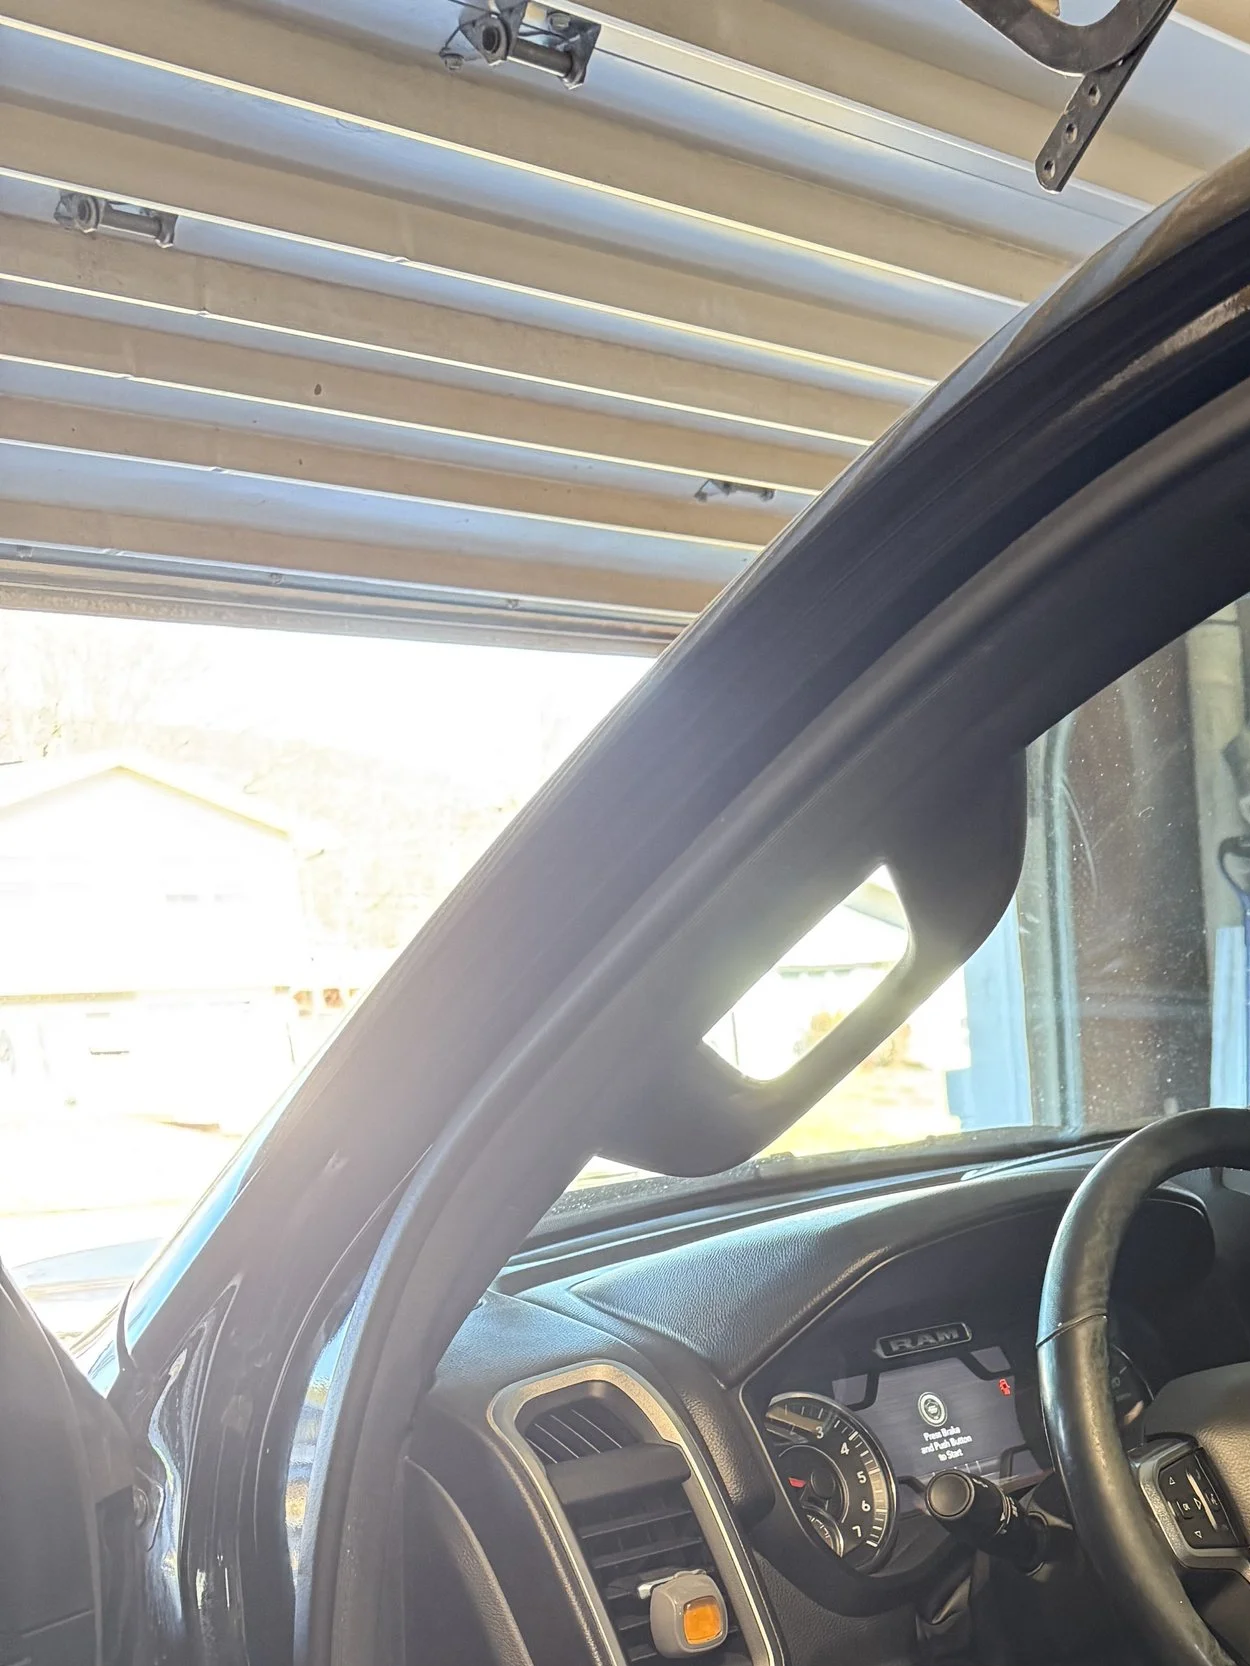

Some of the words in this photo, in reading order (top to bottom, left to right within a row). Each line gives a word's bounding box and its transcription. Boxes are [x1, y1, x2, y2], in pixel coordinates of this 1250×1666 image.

[889, 1327, 959, 1352] RAM
[815, 1426, 824, 1439] 3
[923, 1431, 942, 1441] Press
[940, 1426, 961, 1437] Brake
[840, 1442, 850, 1455] 4
[920, 1443, 935, 1454] and
[933, 1439, 951, 1451] Push
[949, 1435, 973, 1447] Button
[938, 1453, 947, 1462] to
[945, 1448, 964, 1460] Start
[856, 1471, 867, 1484] 5
[861, 1500, 871, 1511] 6
[852, 1525, 862, 1538] 7
